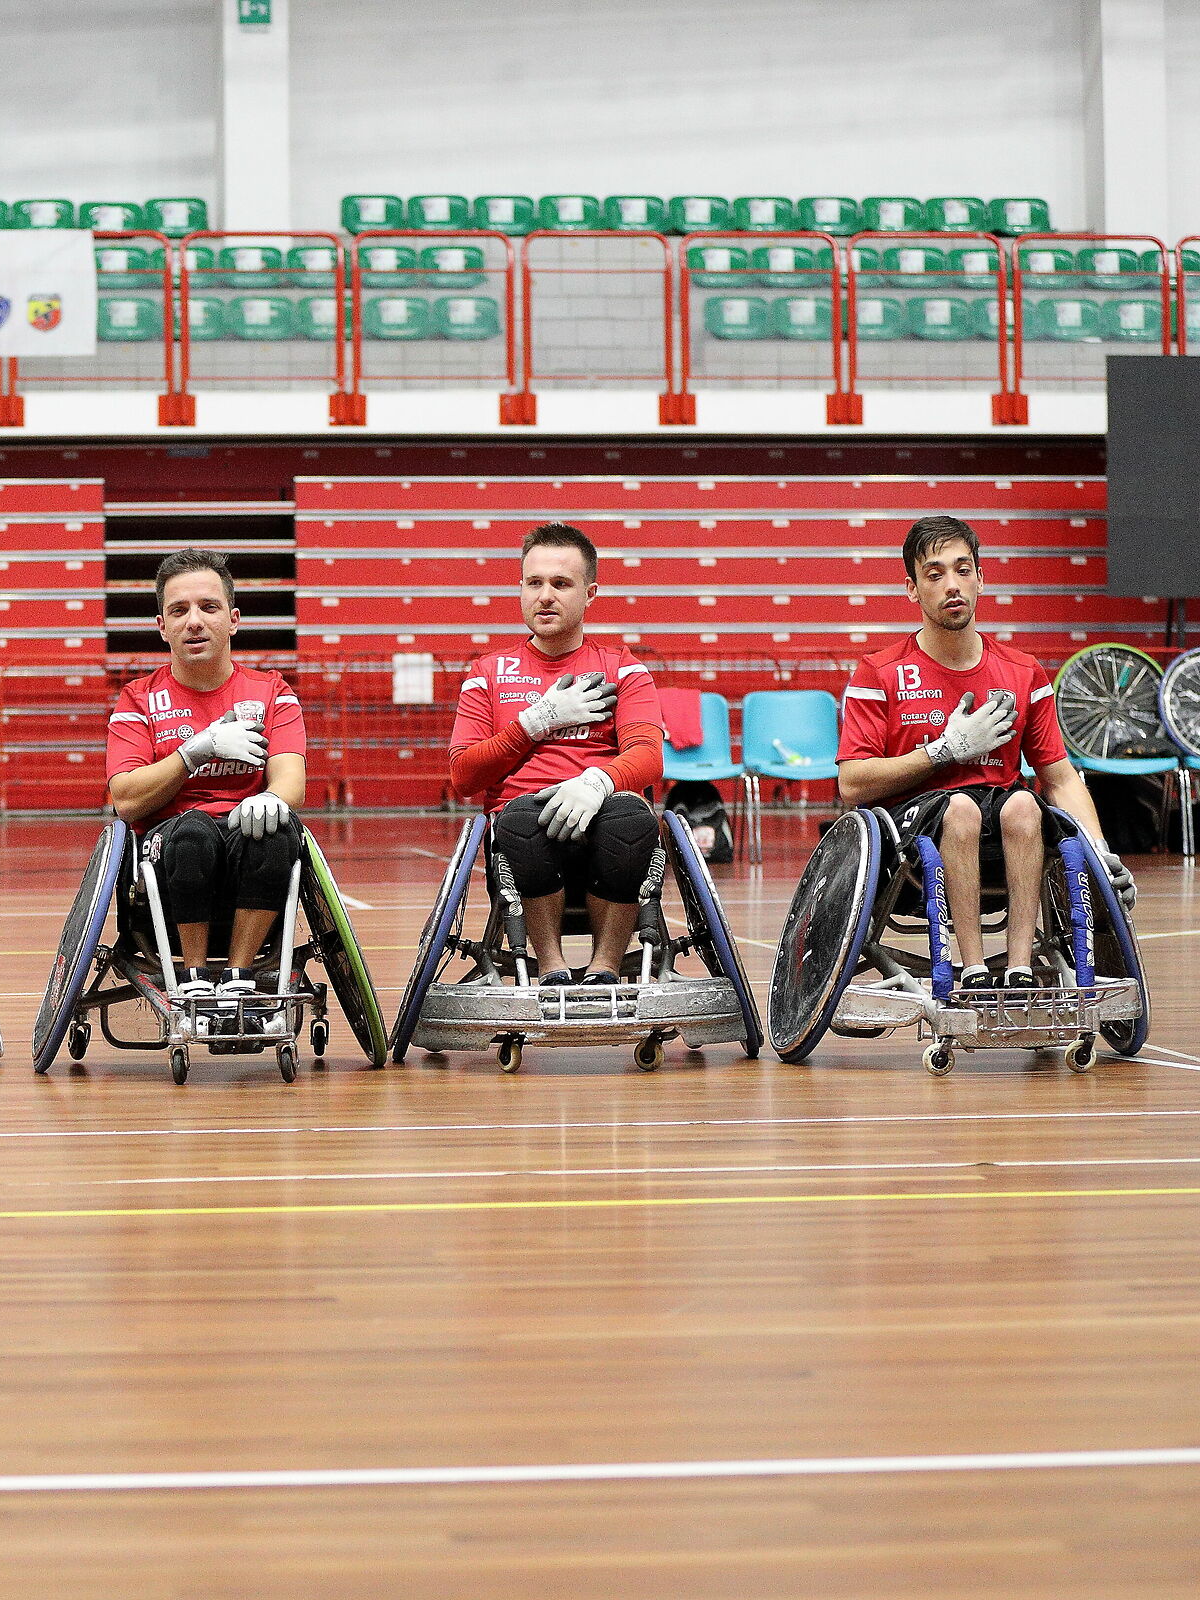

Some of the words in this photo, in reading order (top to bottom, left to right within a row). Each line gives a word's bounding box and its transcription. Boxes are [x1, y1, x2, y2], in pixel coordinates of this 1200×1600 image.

[496, 656, 521, 675] 12
[496, 675, 542, 686] macron
[896, 664, 922, 690] 13
[499, 691, 526, 700] Rotary
[896, 689, 943, 701] macron
[148, 689, 172, 713] 10
[149, 708, 193, 723] macron
[901, 712, 929, 721] Rotary
[156, 728, 178, 739] otary
[988, 758, 1004, 767] SRL
